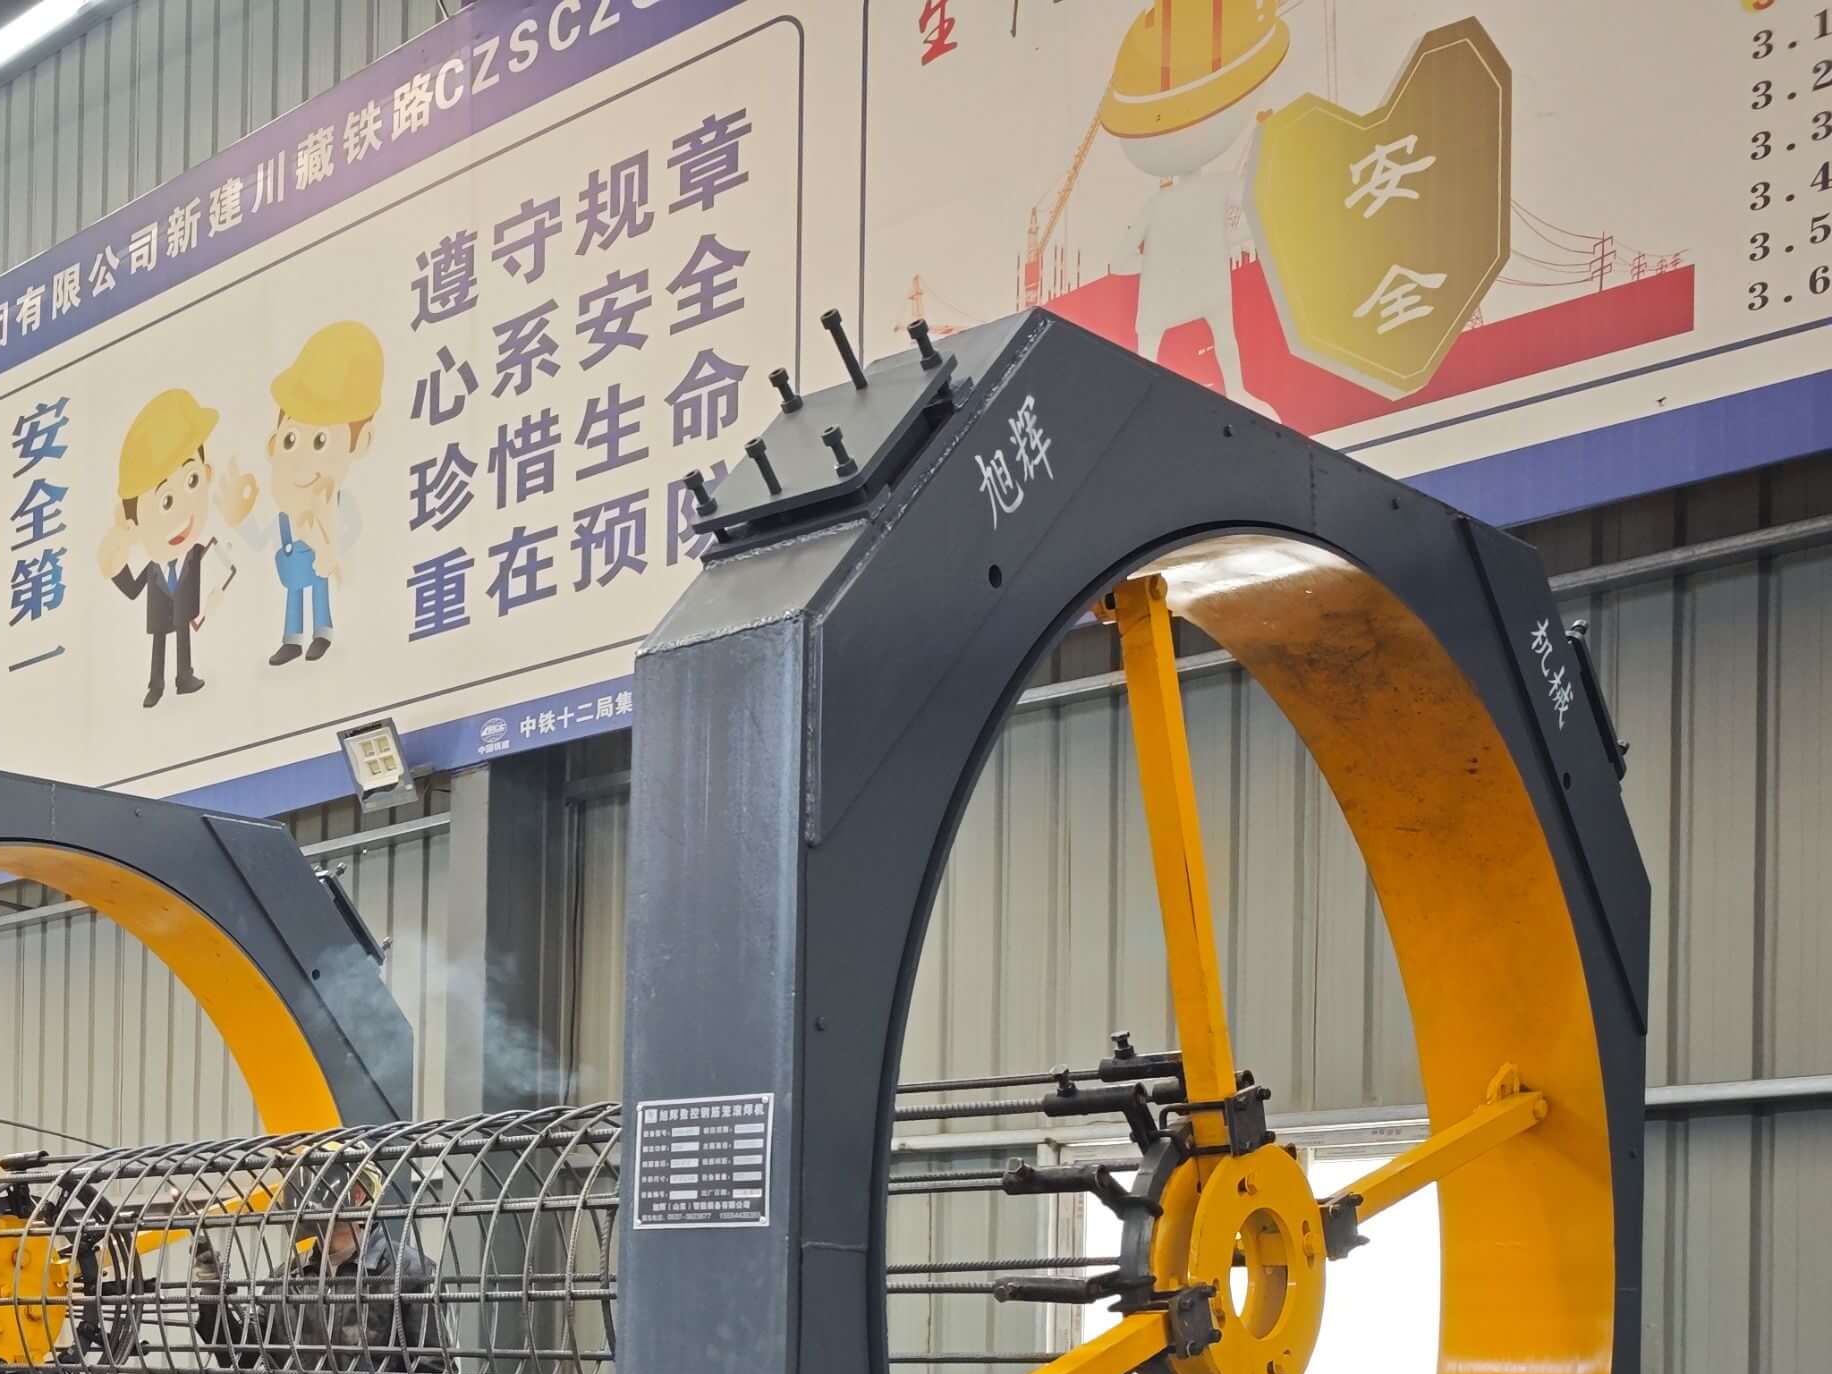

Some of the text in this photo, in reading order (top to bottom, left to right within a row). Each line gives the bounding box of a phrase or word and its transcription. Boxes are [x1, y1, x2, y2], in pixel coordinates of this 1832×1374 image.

[409, 106, 753, 332] 遵守规章
[1344, 134, 1447, 335] 安全
[410, 233, 751, 427] 心系安全
[8, 396, 71, 673] 安全第一
[408, 347, 749, 534] 珍惜生命
[974, 394, 1054, 531] 旭辉
[407, 459, 730, 643] 重在预防
